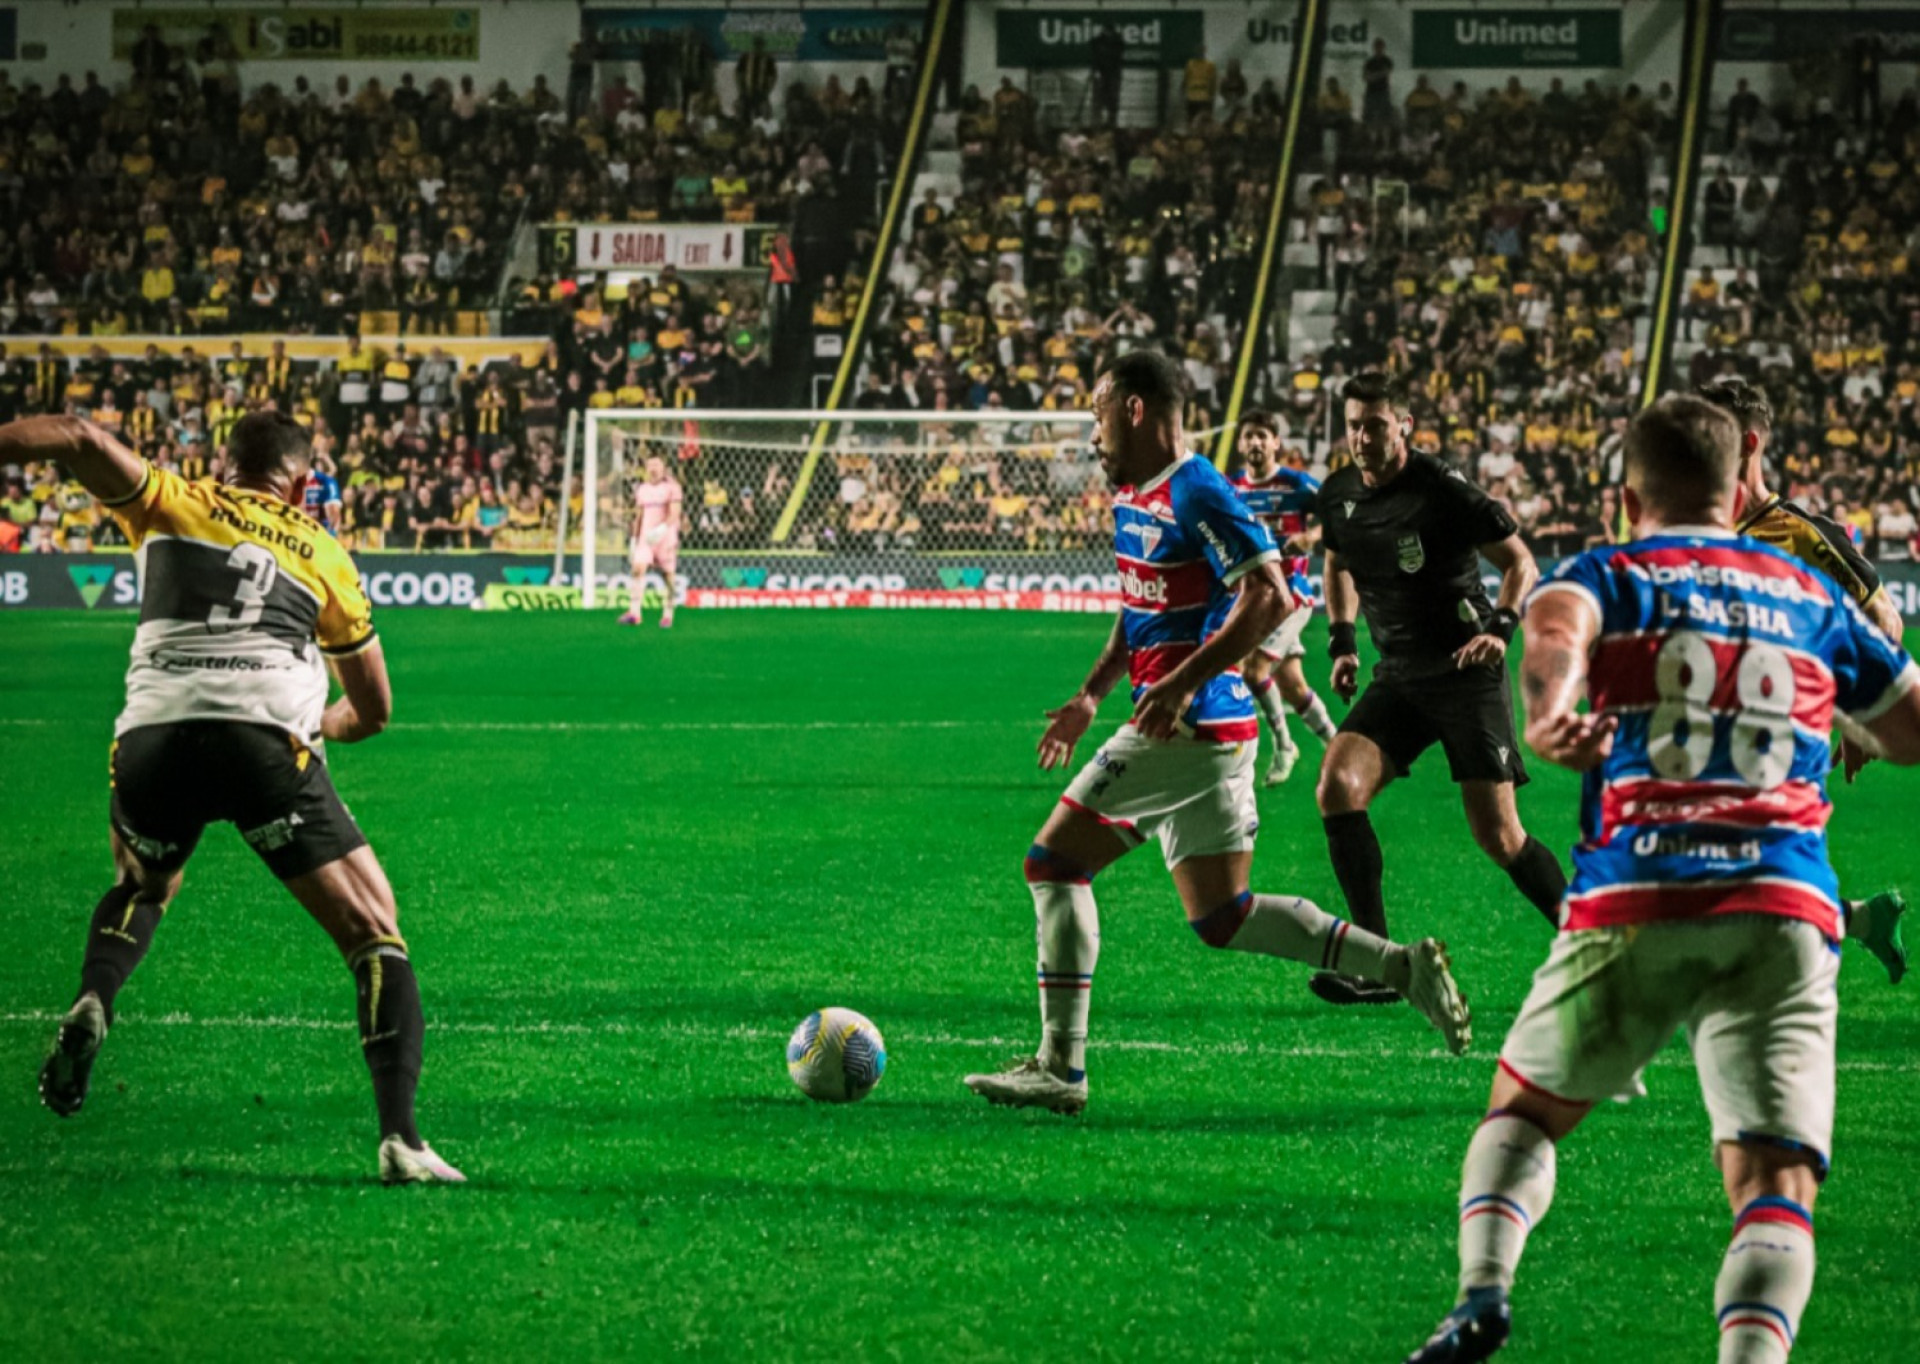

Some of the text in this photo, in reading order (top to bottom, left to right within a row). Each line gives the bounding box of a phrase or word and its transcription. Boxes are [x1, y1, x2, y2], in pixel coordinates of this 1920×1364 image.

[1456, 18, 1578, 45] Unimed
[554, 230, 571, 263] 5
[684, 243, 710, 264] EXIT
[205, 540, 279, 635] 3
[1689, 593, 1795, 638] SASHA
[1647, 630, 1796, 791] 88
